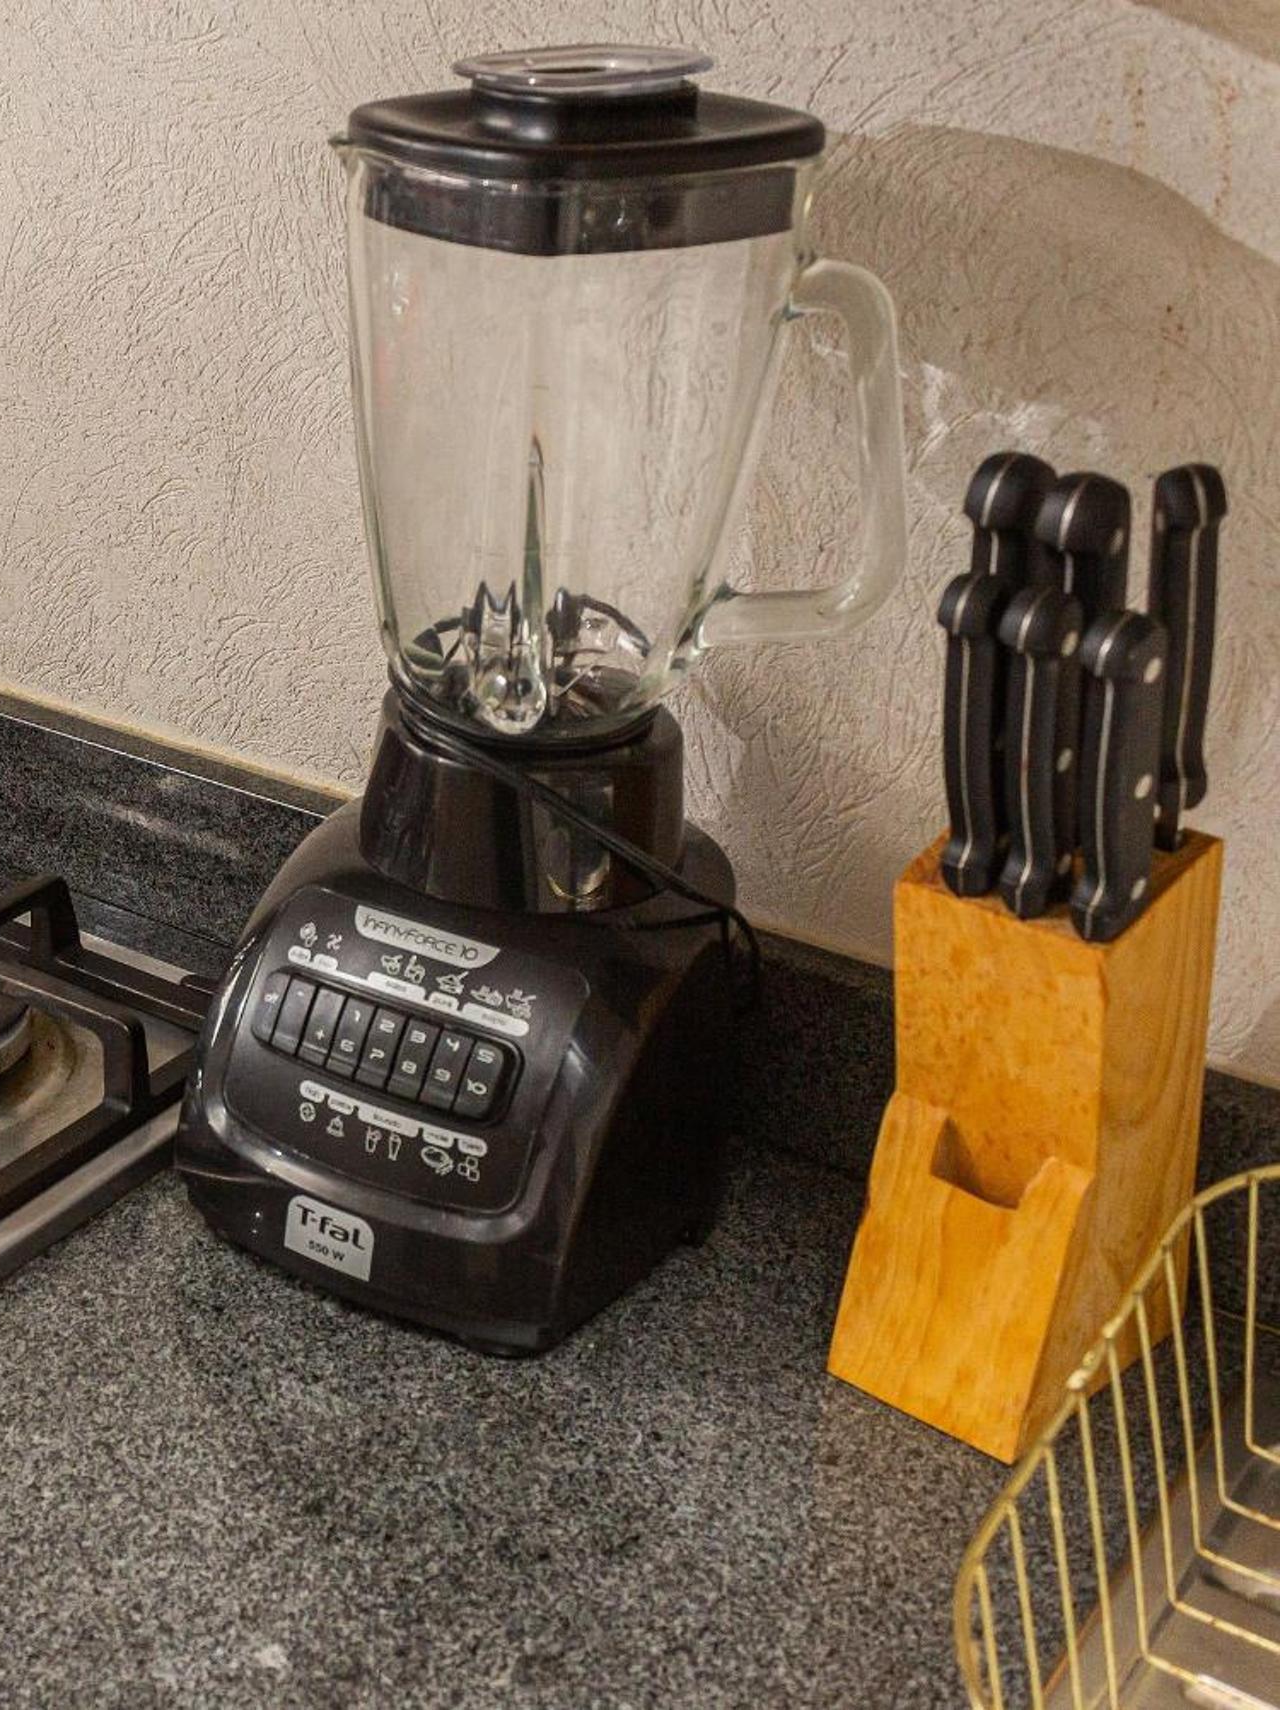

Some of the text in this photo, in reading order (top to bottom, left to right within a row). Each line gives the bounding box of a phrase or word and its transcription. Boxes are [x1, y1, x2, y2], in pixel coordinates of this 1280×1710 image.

[460, 944, 479, 961] 10
[353, 1009, 495, 1064] 1 2 3 4 5
[340, 1039, 487, 1095] 6 7 8 9 10
[296, 1203, 365, 1251] T-fal
[332, 1249, 345, 1261] W
